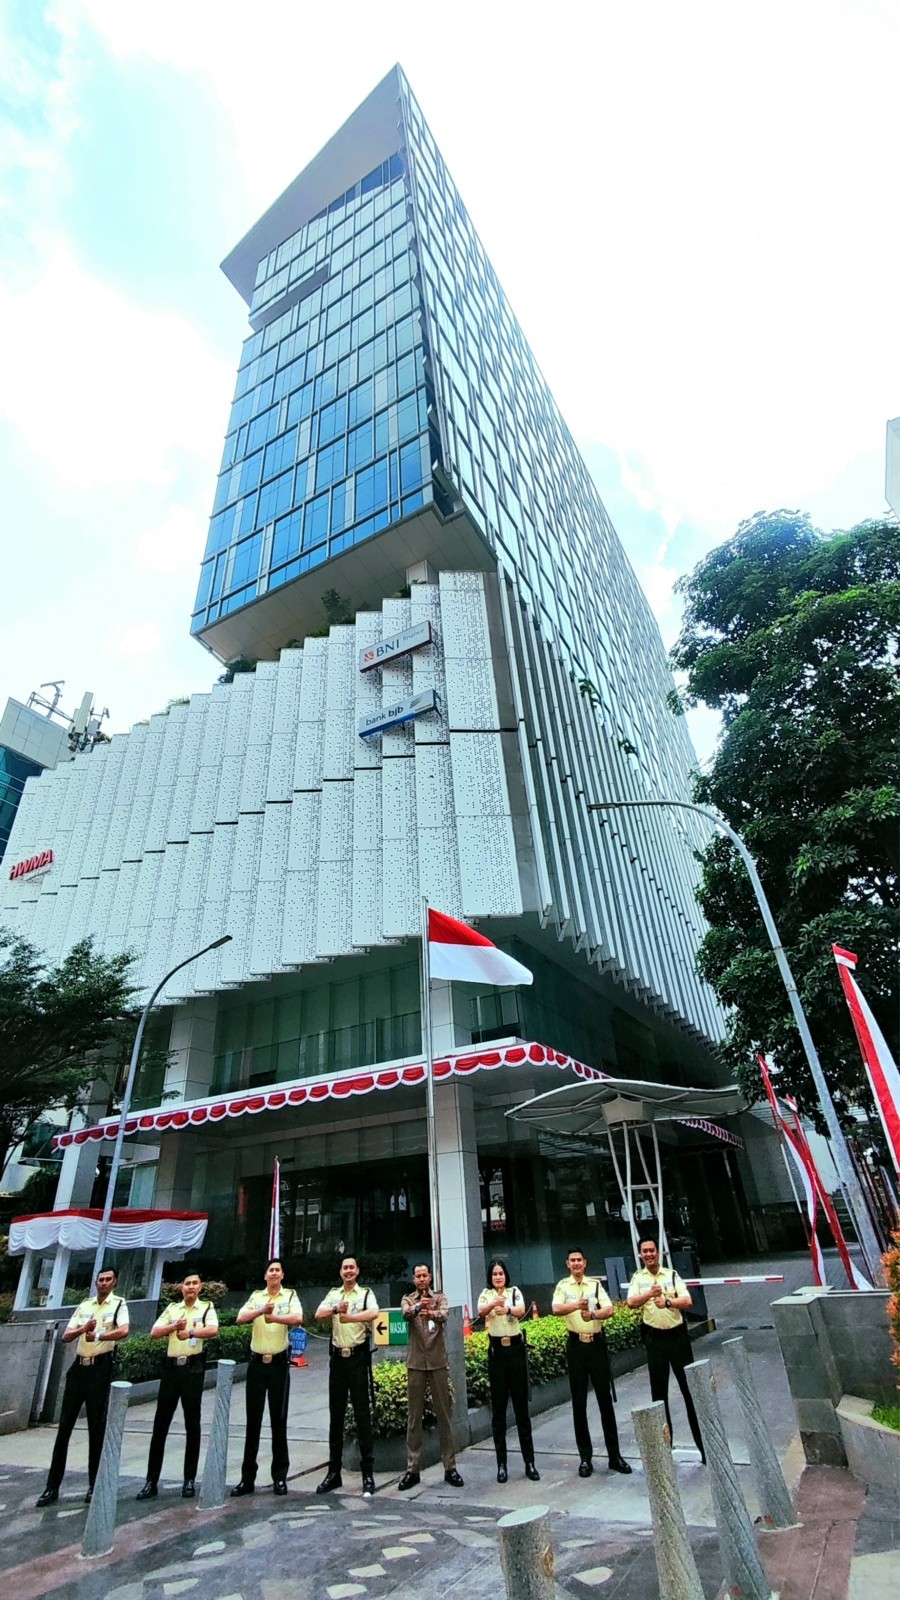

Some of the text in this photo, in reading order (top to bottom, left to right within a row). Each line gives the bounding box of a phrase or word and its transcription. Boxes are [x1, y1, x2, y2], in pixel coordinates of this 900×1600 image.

[376, 628, 425, 657] BNI finance
[365, 713, 386, 726] bank
[388, 706, 404, 718] bjb
[390, 1321, 407, 1334] MASUK
